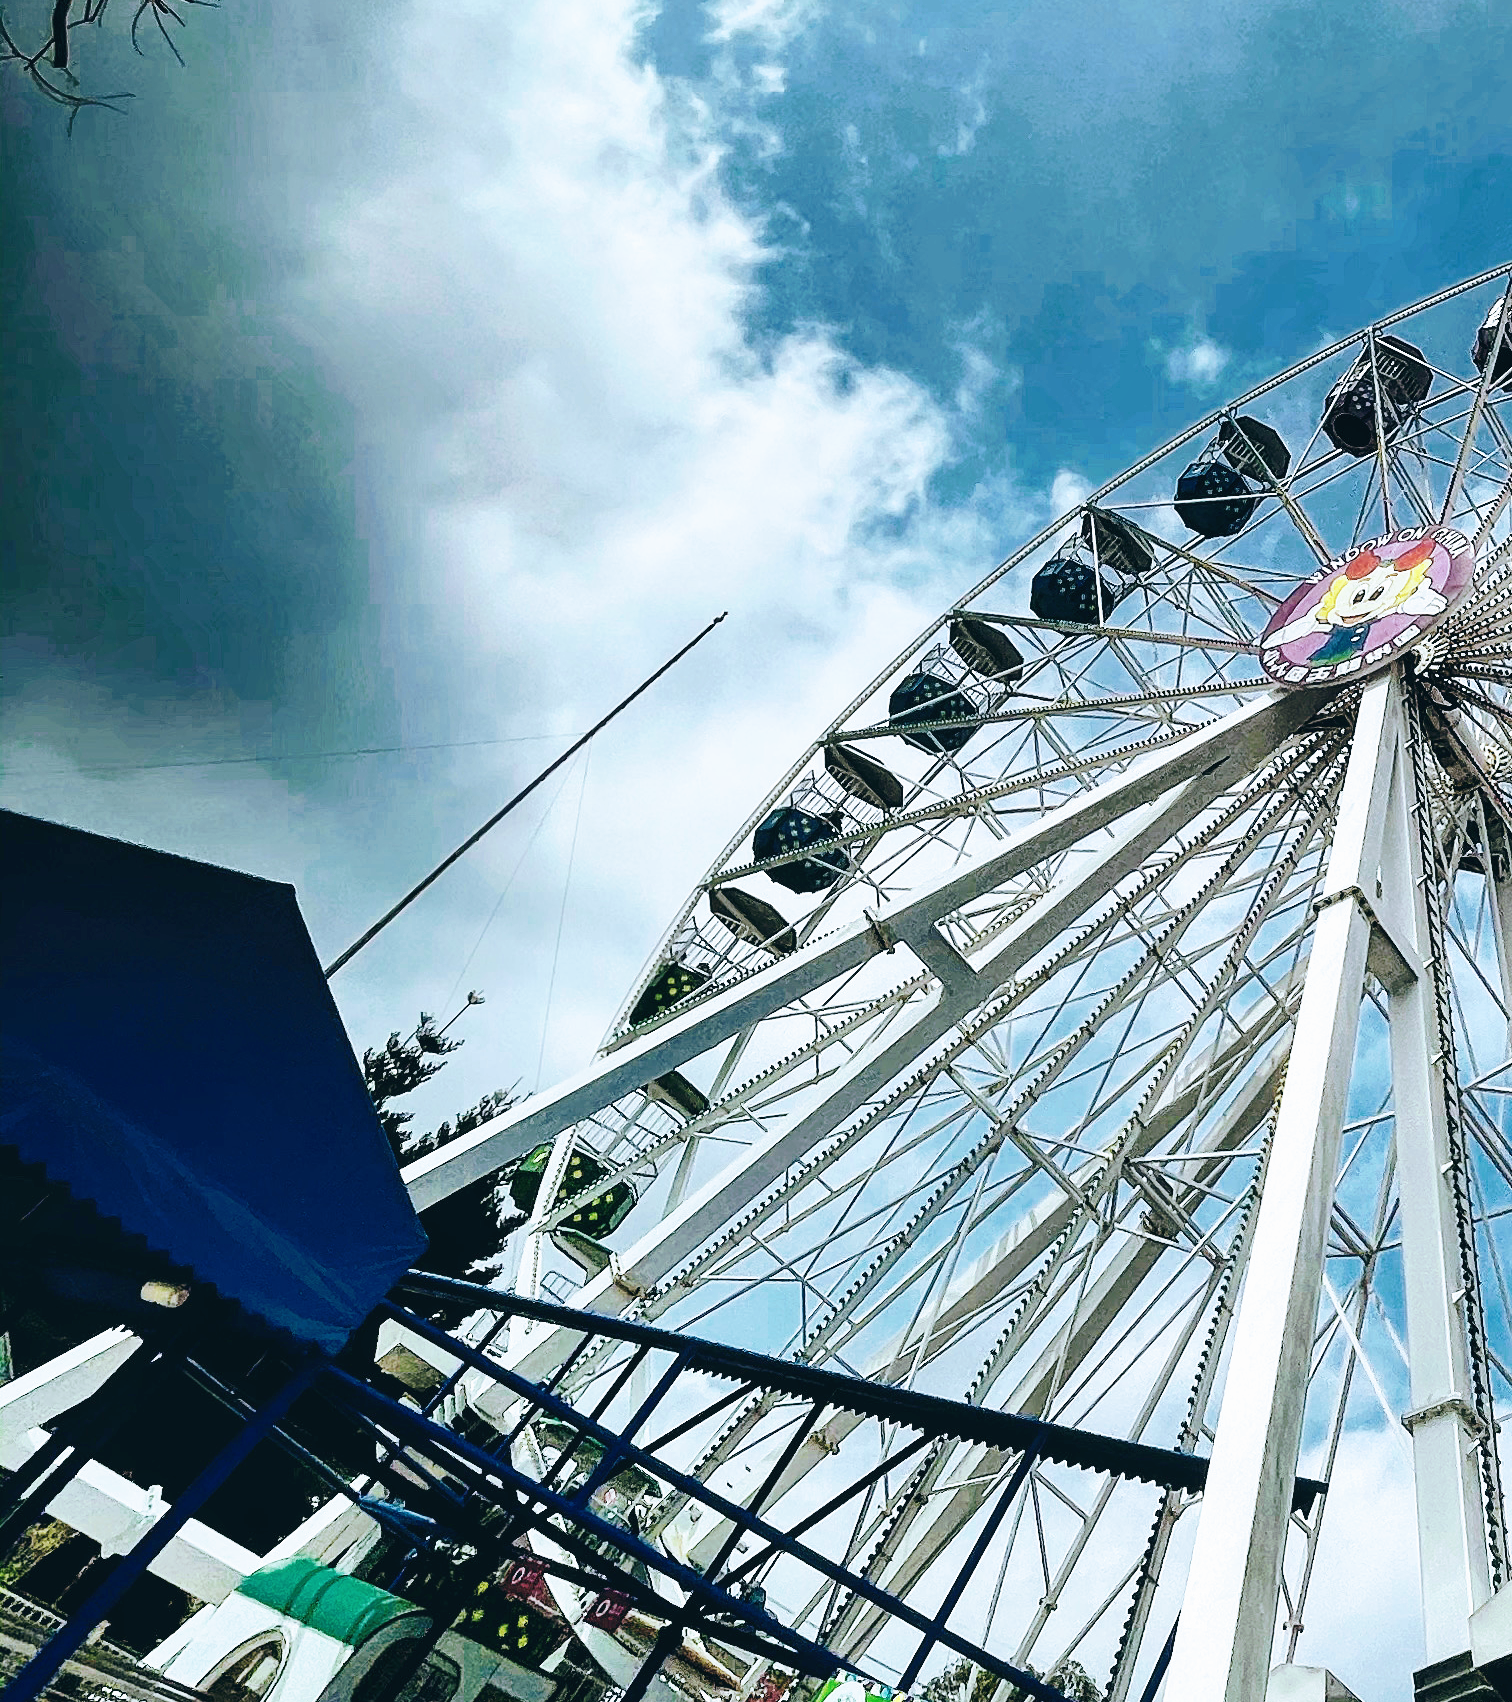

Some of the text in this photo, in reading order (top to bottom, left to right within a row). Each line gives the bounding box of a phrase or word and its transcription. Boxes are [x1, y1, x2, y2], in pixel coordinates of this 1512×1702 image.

[1305, 526, 1471, 585] WINDOW ON CHINA
